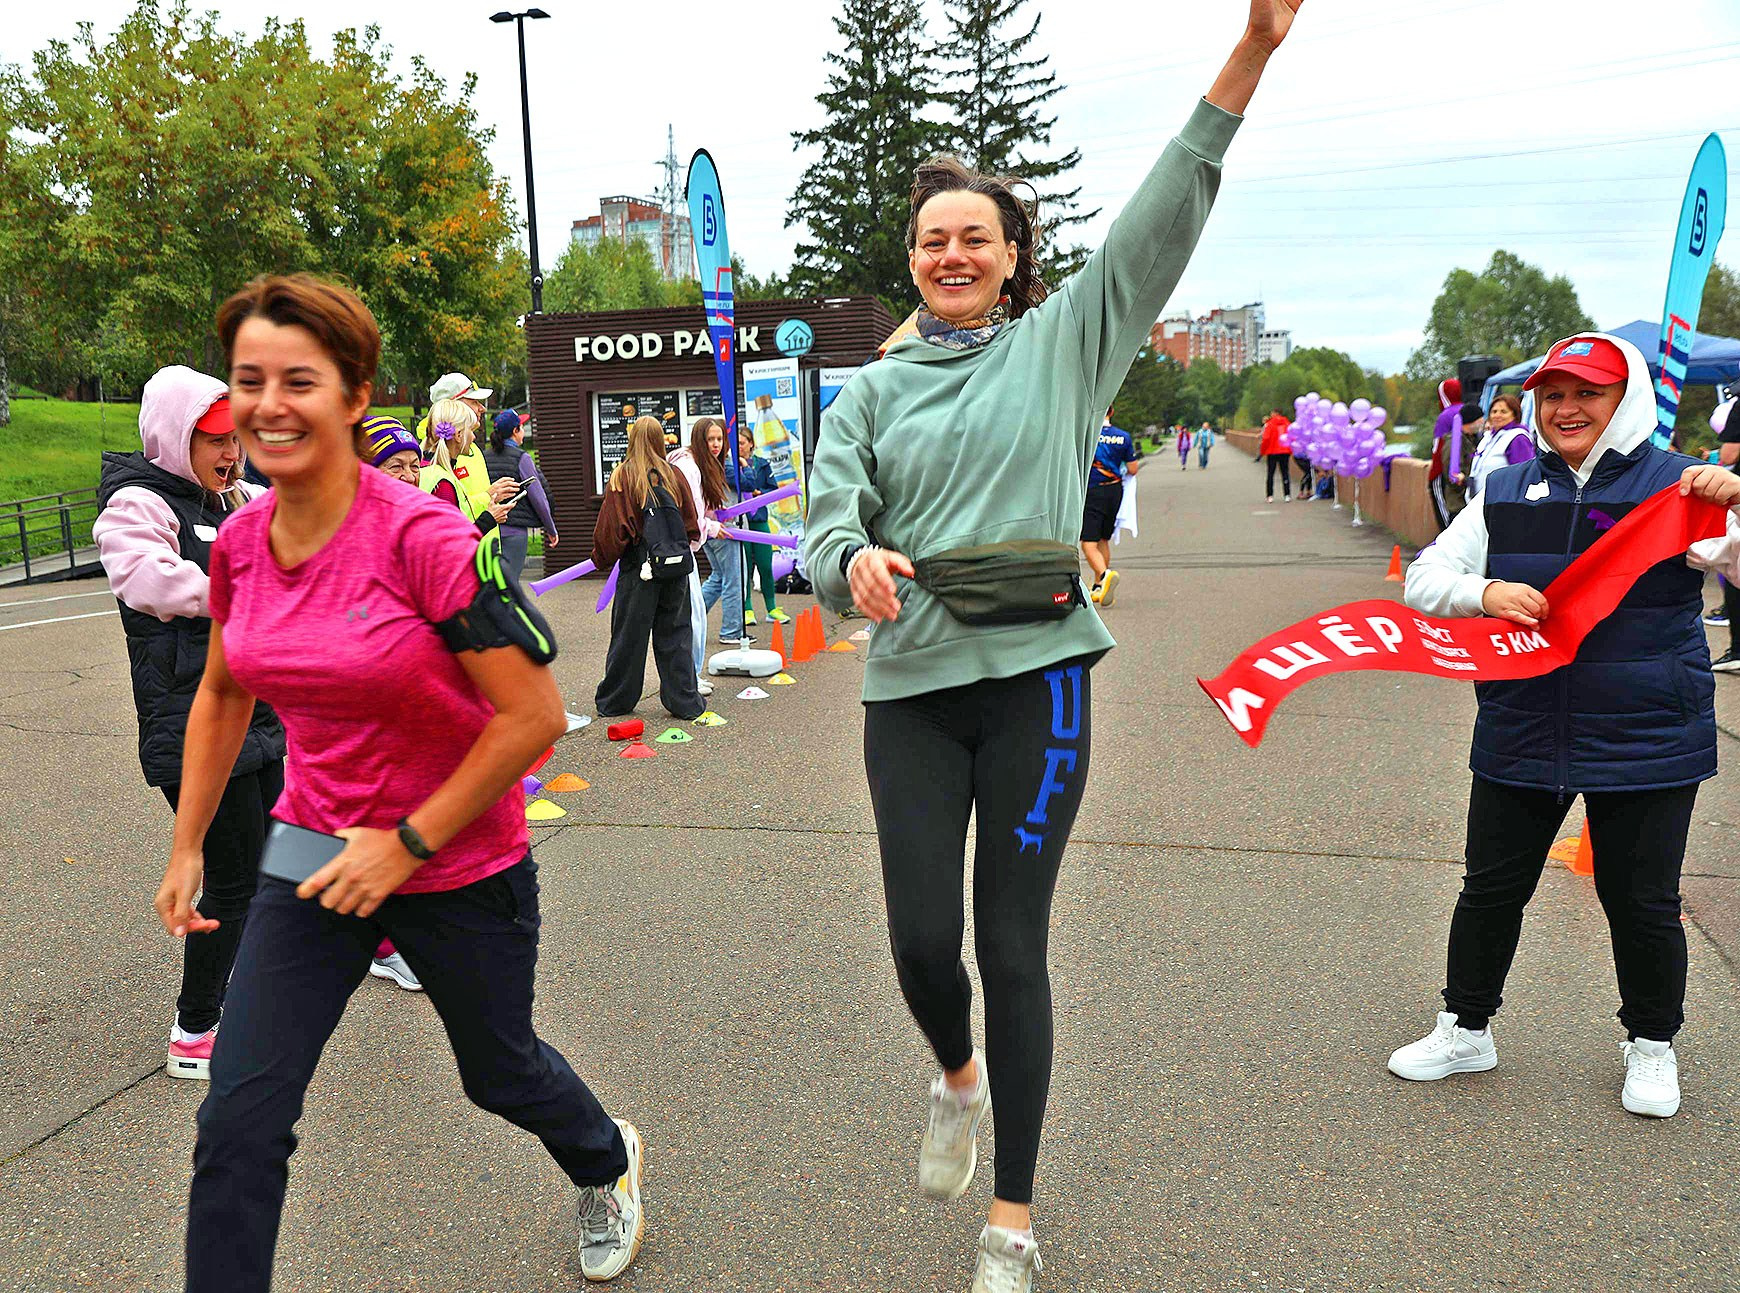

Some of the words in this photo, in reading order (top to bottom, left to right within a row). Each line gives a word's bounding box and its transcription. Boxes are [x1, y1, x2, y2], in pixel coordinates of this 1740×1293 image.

[574, 332, 663, 362] FOOD
[673, 326, 761, 356] PAK
[1489, 634, 1510, 656] 5
[1507, 630, 1551, 653] КМ
